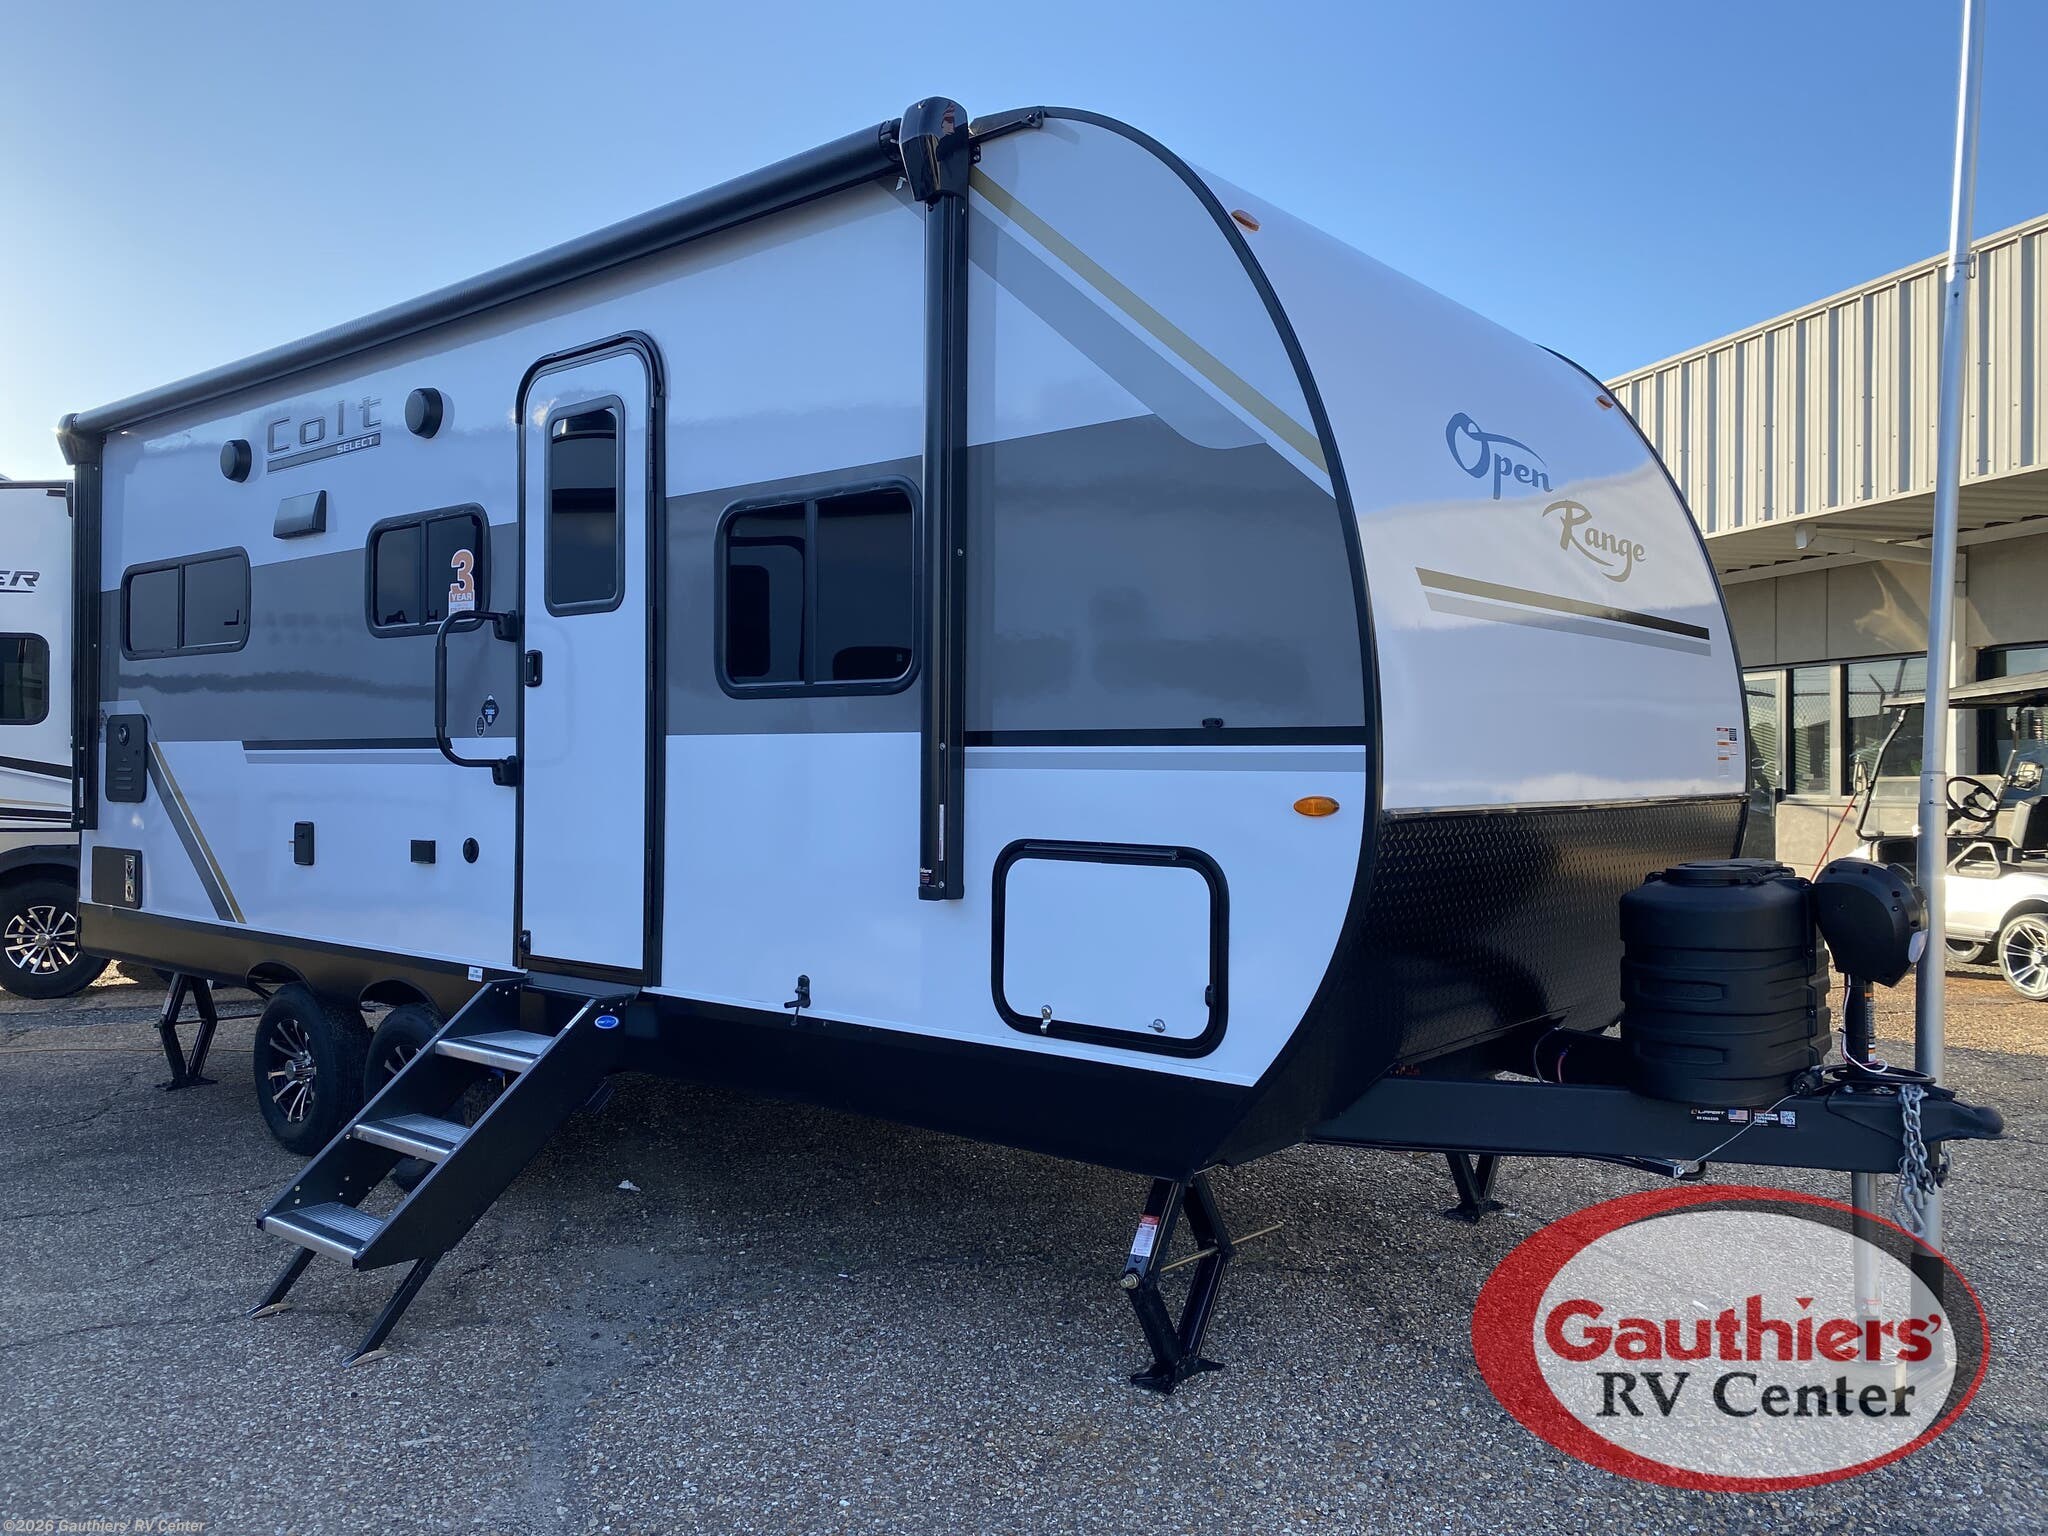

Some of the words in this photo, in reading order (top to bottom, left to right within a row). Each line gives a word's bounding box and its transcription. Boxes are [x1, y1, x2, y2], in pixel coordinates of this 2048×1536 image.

[267, 396, 381, 453] Colt
[336, 436, 375, 455] SELECT
[1445, 412, 1554, 500] Open
[1542, 500, 1647, 583] Range
[451, 549, 474, 594] 3
[451, 592, 473, 601] YEAR
